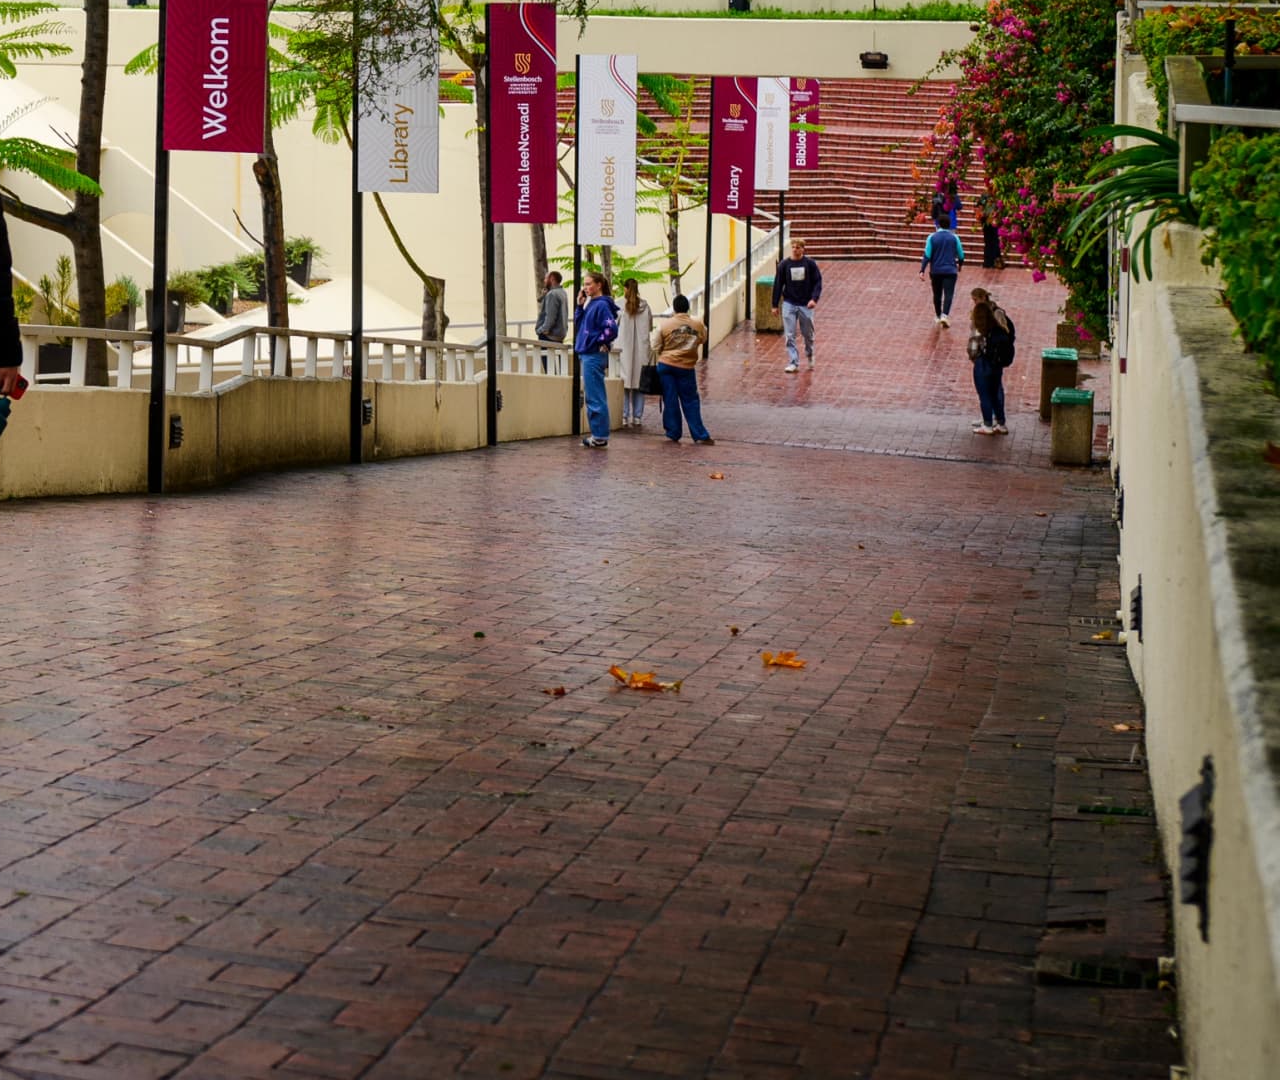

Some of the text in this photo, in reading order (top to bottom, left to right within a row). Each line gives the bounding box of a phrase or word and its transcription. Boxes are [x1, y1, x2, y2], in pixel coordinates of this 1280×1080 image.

[202, 17, 230, 140] Welkom
[389, 103, 414, 184] Library
[517, 103, 530, 172] leeNcwadi
[796, 114, 806, 166] Bibliotk
[517, 174, 530, 215] iThala
[600, 155, 615, 238] Biblioteek
[727, 165, 742, 209] Library
